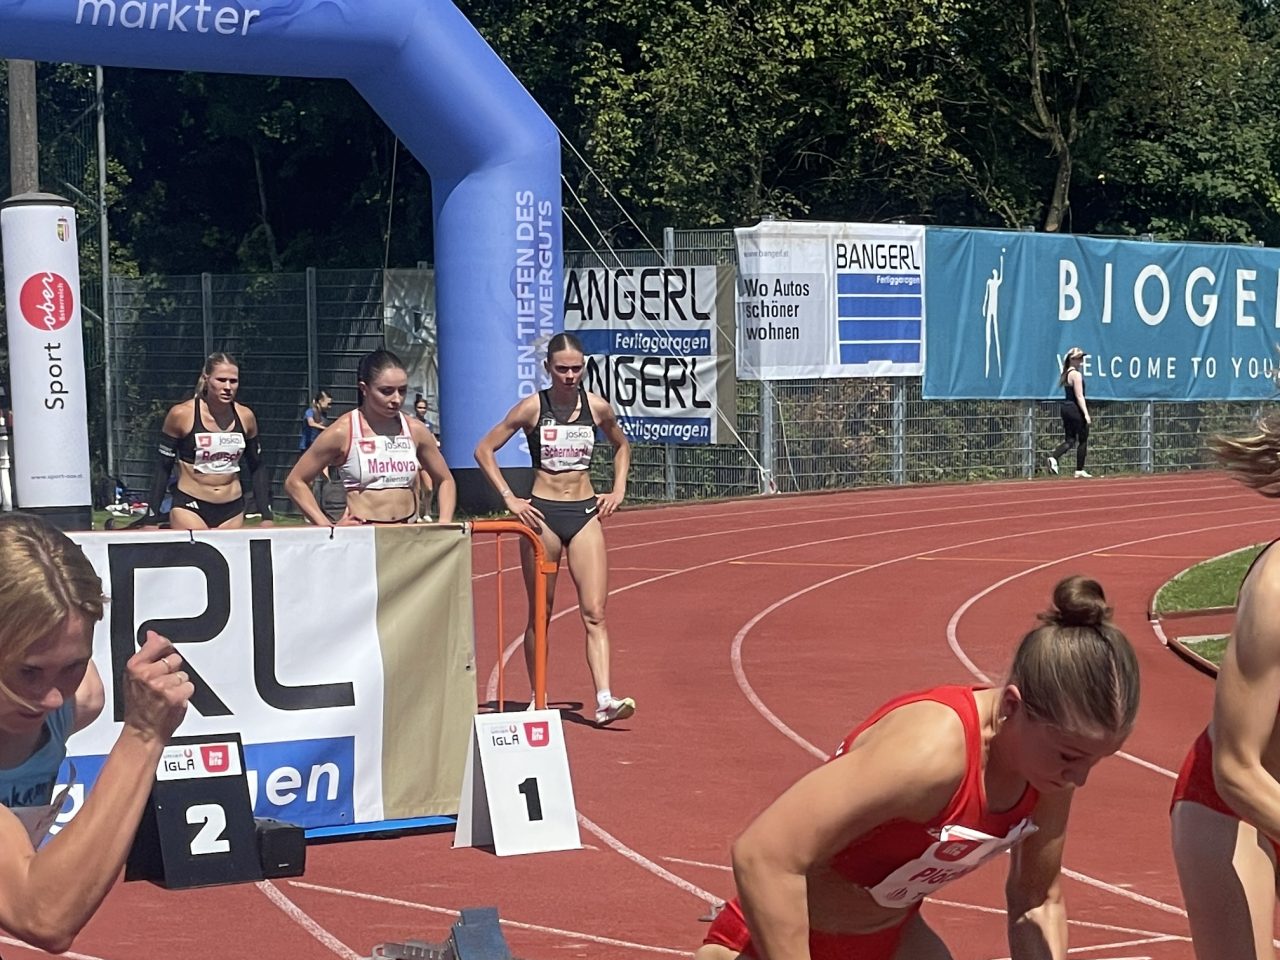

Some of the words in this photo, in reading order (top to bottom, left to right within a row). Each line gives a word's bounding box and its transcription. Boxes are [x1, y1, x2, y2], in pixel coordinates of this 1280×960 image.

[515, 190, 535, 242] DES
[836, 243, 920, 270] BANGERL
[516, 248, 536, 339] TIEFEN
[563, 267, 711, 321] ANGERL
[743, 278, 769, 297] Wo
[773, 278, 810, 297] Autos
[745, 299, 800, 318] schöner
[746, 321, 800, 340] wohnen
[615, 332, 709, 354] Fertiggaragen
[44, 342, 69, 410] Sport
[1190, 357, 1217, 378] TO
[586, 355, 712, 409] NGERL
[367, 457, 416, 473] Markova
[491, 734, 520, 746] IGLA
[164, 759, 195, 772] IGLA
[518, 777, 543, 821] 1
[185, 803, 231, 856] 2
